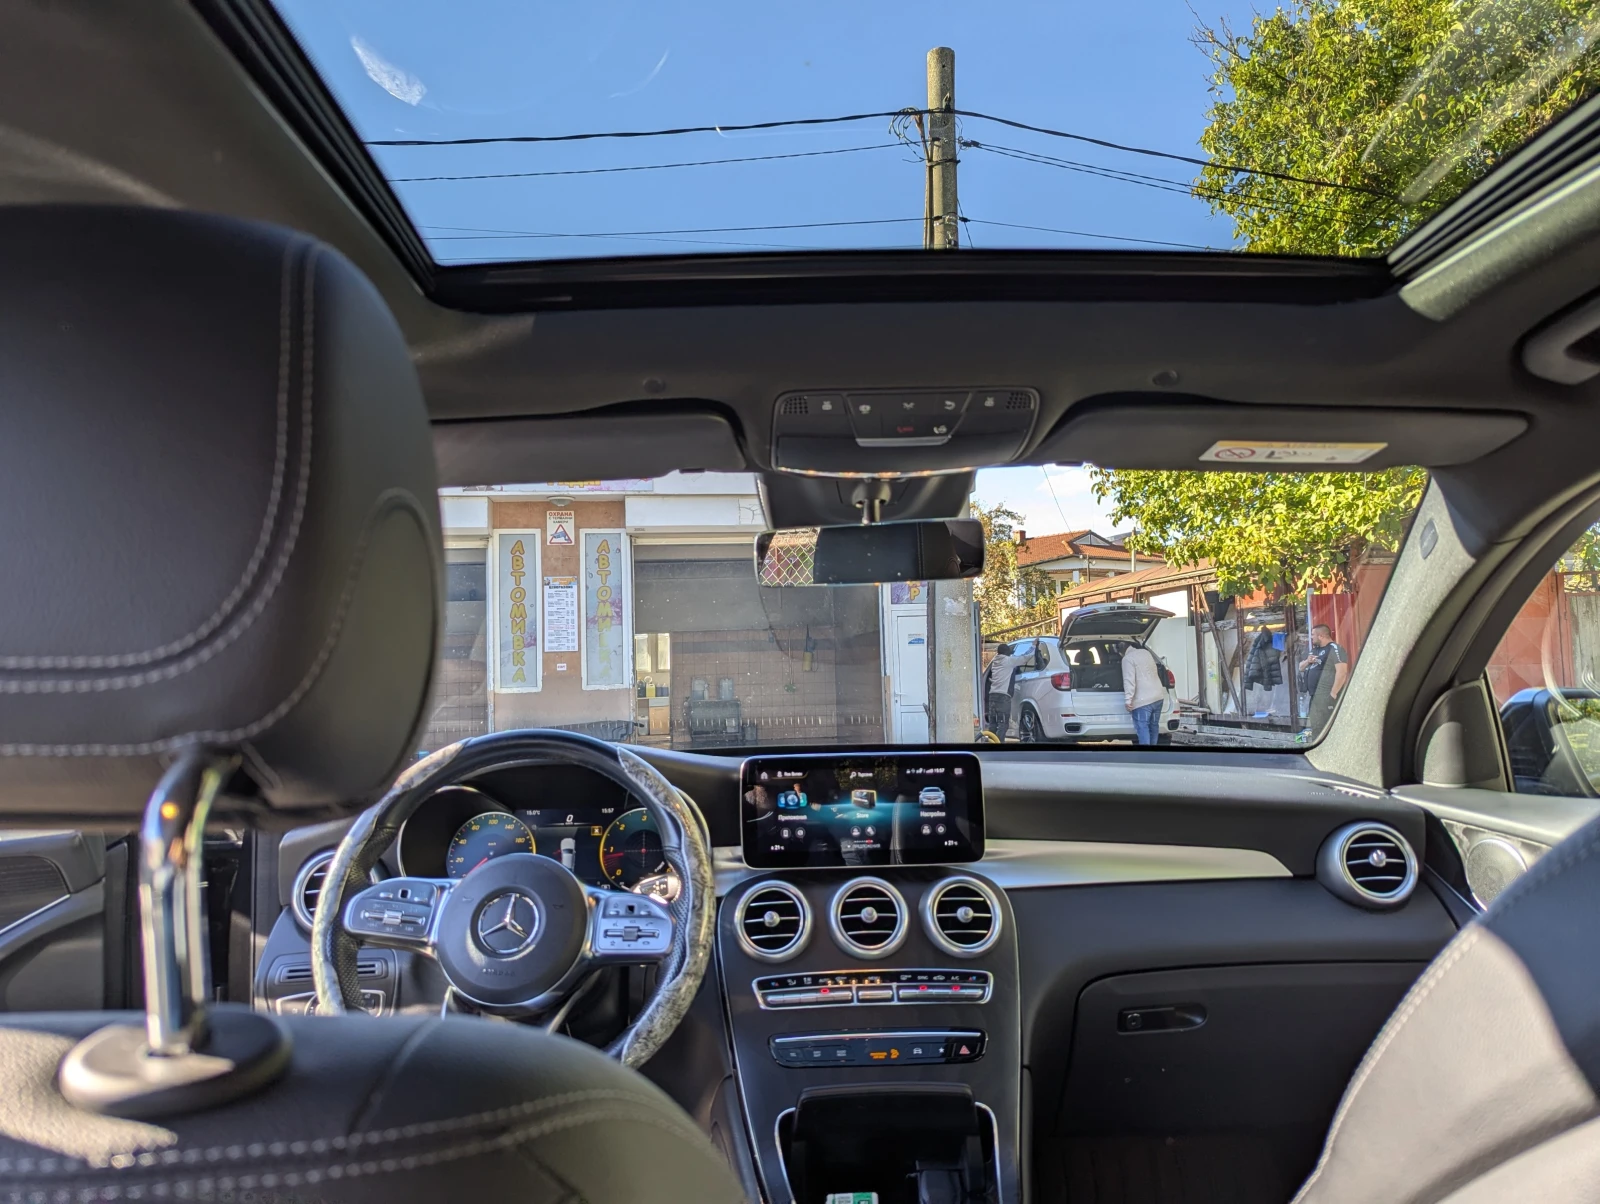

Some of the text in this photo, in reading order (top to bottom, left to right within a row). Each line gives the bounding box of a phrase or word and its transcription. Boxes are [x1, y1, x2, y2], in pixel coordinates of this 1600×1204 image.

[510, 539, 527, 683] АВТОМИВКА
[565, 814, 574, 823] 0
[615, 868, 622, 876] 0
